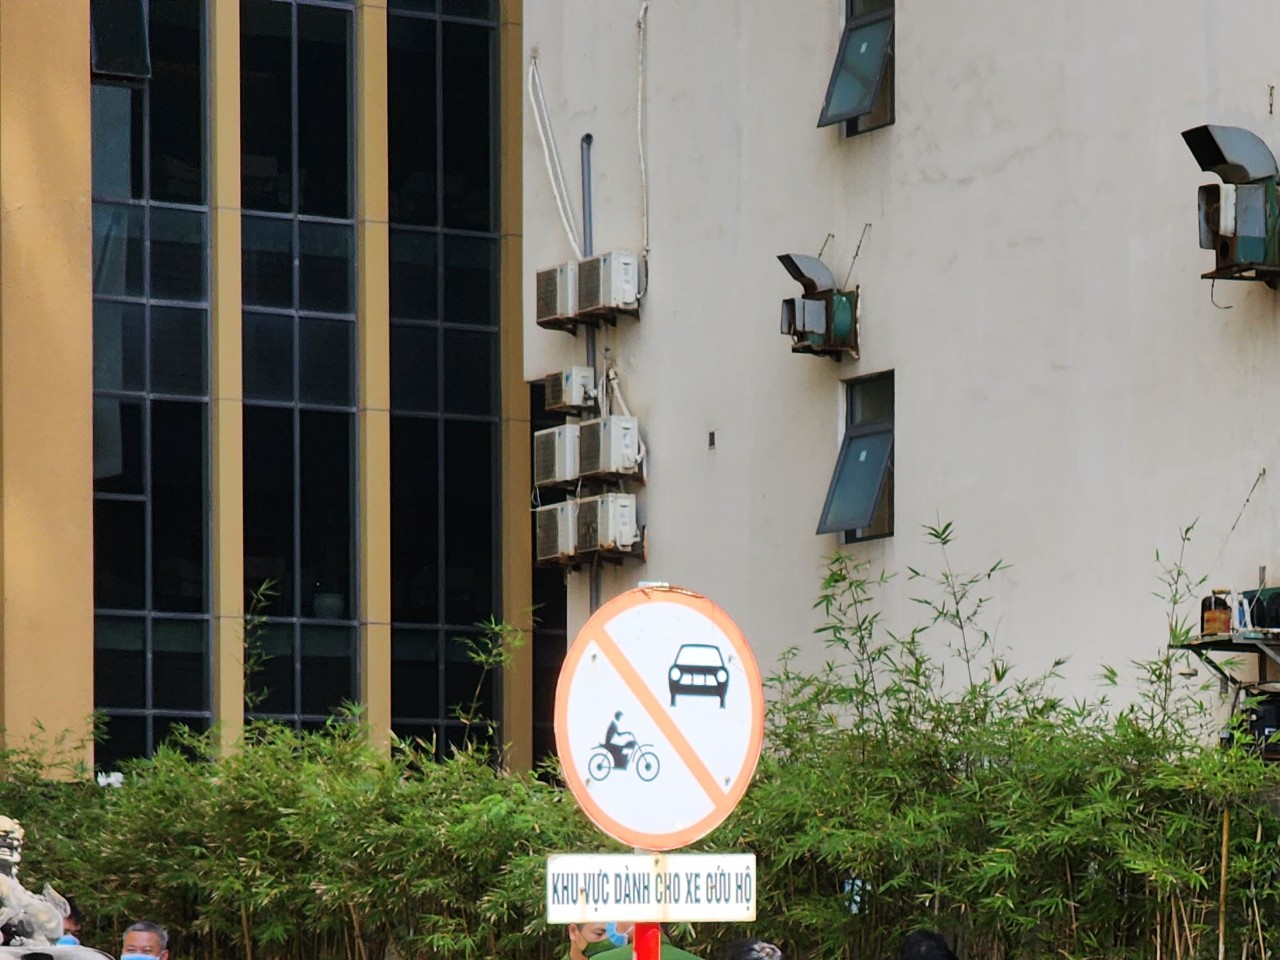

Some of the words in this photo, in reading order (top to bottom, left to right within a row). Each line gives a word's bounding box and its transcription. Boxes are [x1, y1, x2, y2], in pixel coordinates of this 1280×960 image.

[552, 872, 579, 905] KHU
[583, 869, 609, 912] VỰC
[614, 865, 650, 905] DÀNH
[655, 872, 680, 905] CHO
[685, 872, 701, 904] XE
[735, 866, 752, 911] HỘ
